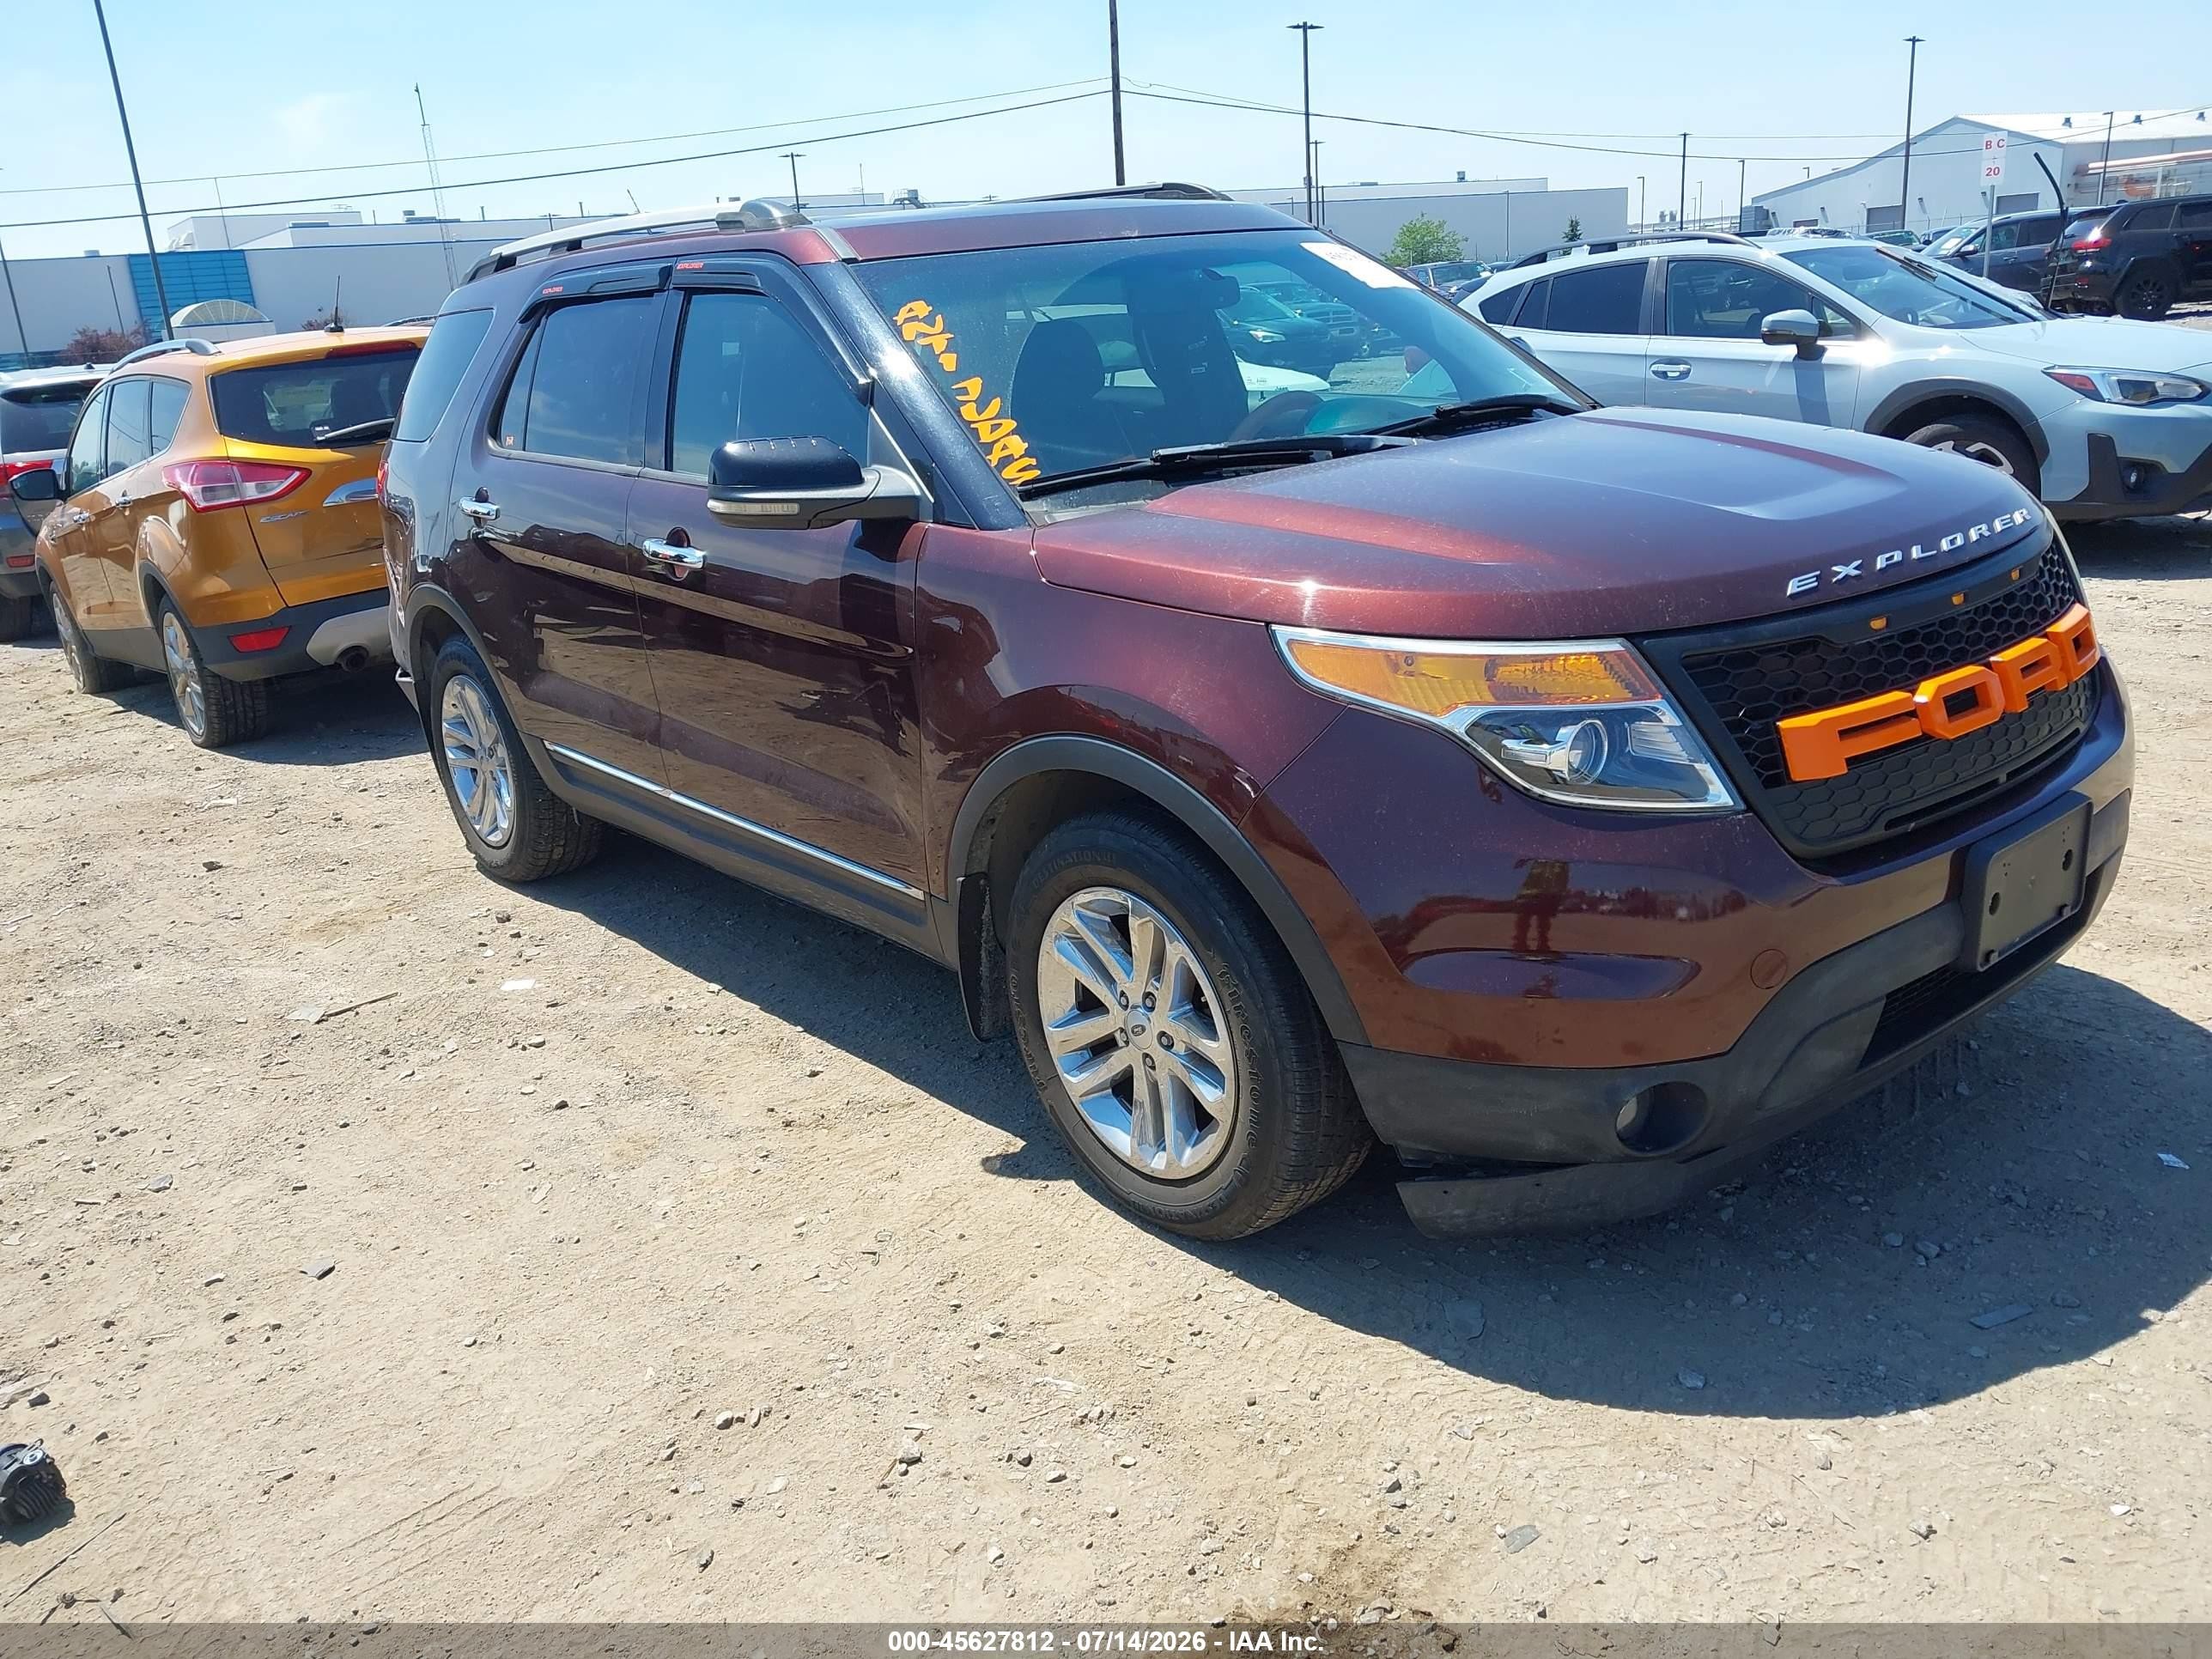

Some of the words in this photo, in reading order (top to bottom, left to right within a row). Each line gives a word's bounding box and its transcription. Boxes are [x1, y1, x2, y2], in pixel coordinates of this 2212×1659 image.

[1985, 140, 1993, 150] B
[1996, 138, 2006, 149] C
[1985, 167, 2001, 177] 20
[1786, 507, 2033, 598] EXPLORER
[1775, 603, 2101, 782] FORD
